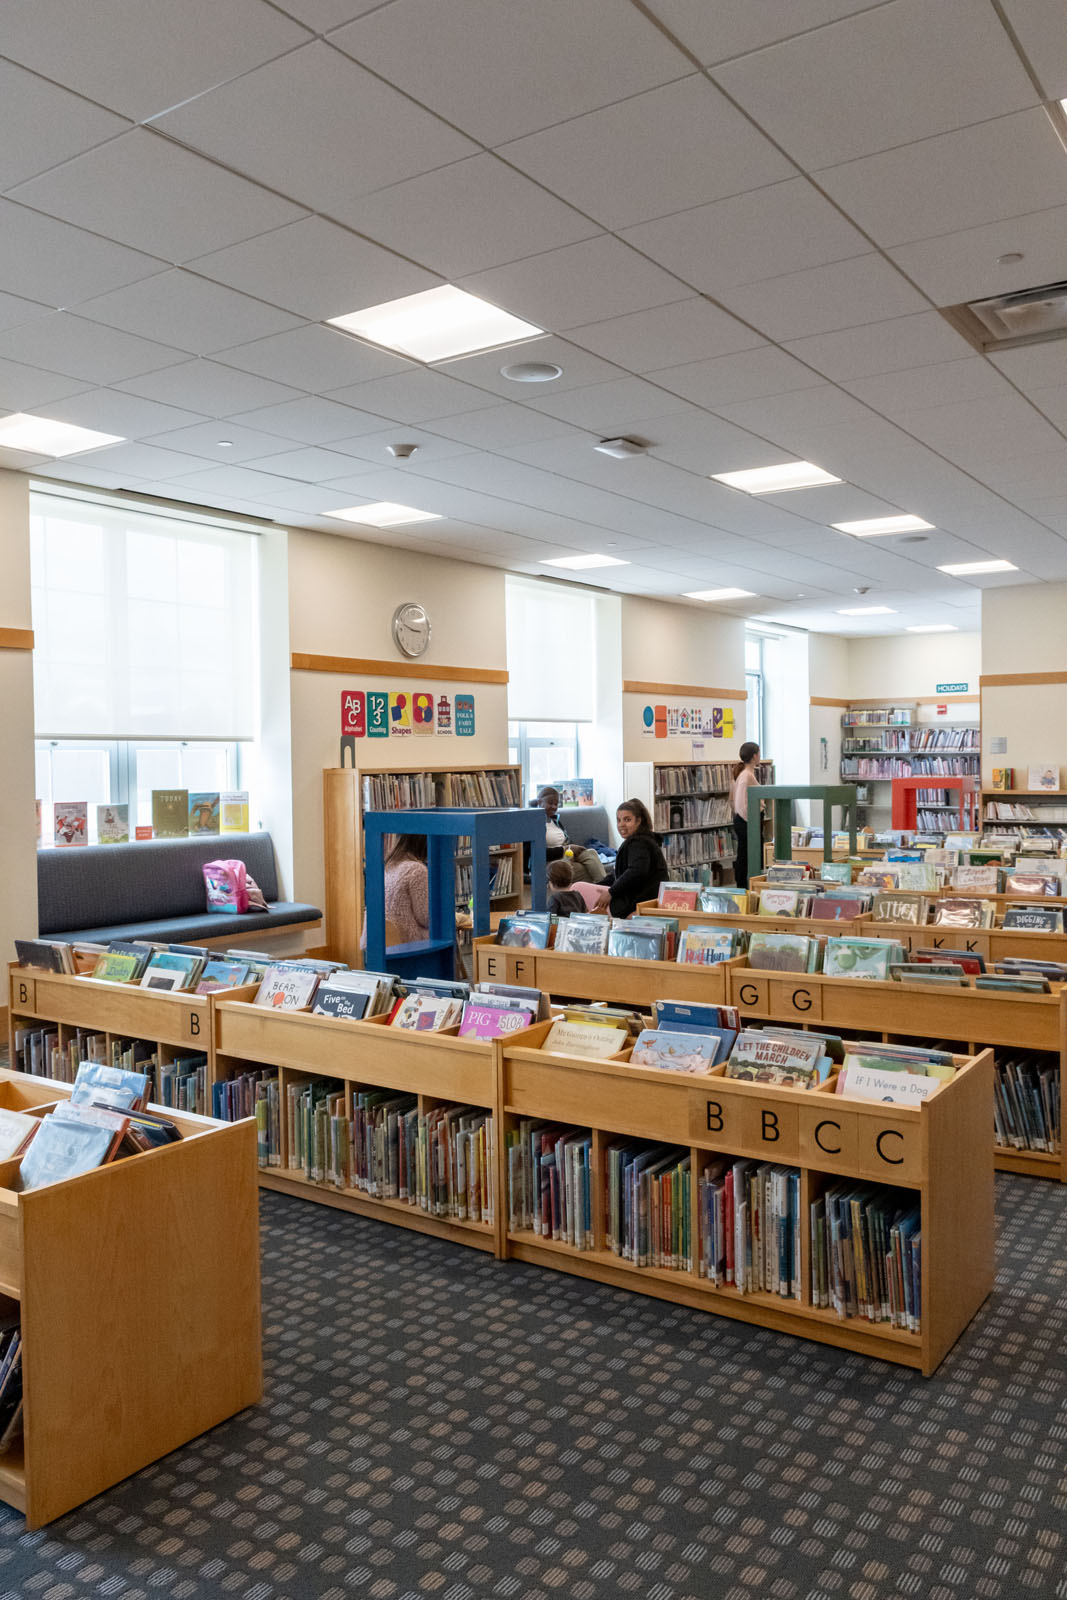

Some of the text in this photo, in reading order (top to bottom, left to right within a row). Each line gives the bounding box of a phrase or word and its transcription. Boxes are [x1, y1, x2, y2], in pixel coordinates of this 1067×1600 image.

[937, 684, 967, 692] HOLIDAYS
[391, 726, 412, 735] Shapes
[878, 901, 915, 920] STUCK
[1016, 915, 1047, 924] DIGGING
[488, 958, 497, 976] E
[516, 961, 524, 979] F
[19, 983, 28, 1003] B
[323, 994, 341, 1004] Five
[739, 984, 759, 1006] G
[792, 989, 812, 1011] G
[337, 1003, 354, 1014] Bed
[190, 1013, 200, 1035] B
[467, 1011, 522, 1030] PIG SLOB
[738, 1042, 812, 1062] LET THE CHILDREN
[754, 1051, 789, 1065] MARCH
[855, 1075, 864, 1085] If
[873, 1079, 897, 1091] Were
[910, 1084, 928, 1097] Dog
[706, 1100, 724, 1132] B
[761, 1110, 780, 1142] B
[814, 1120, 841, 1154] C
[876, 1129, 904, 1165] C
